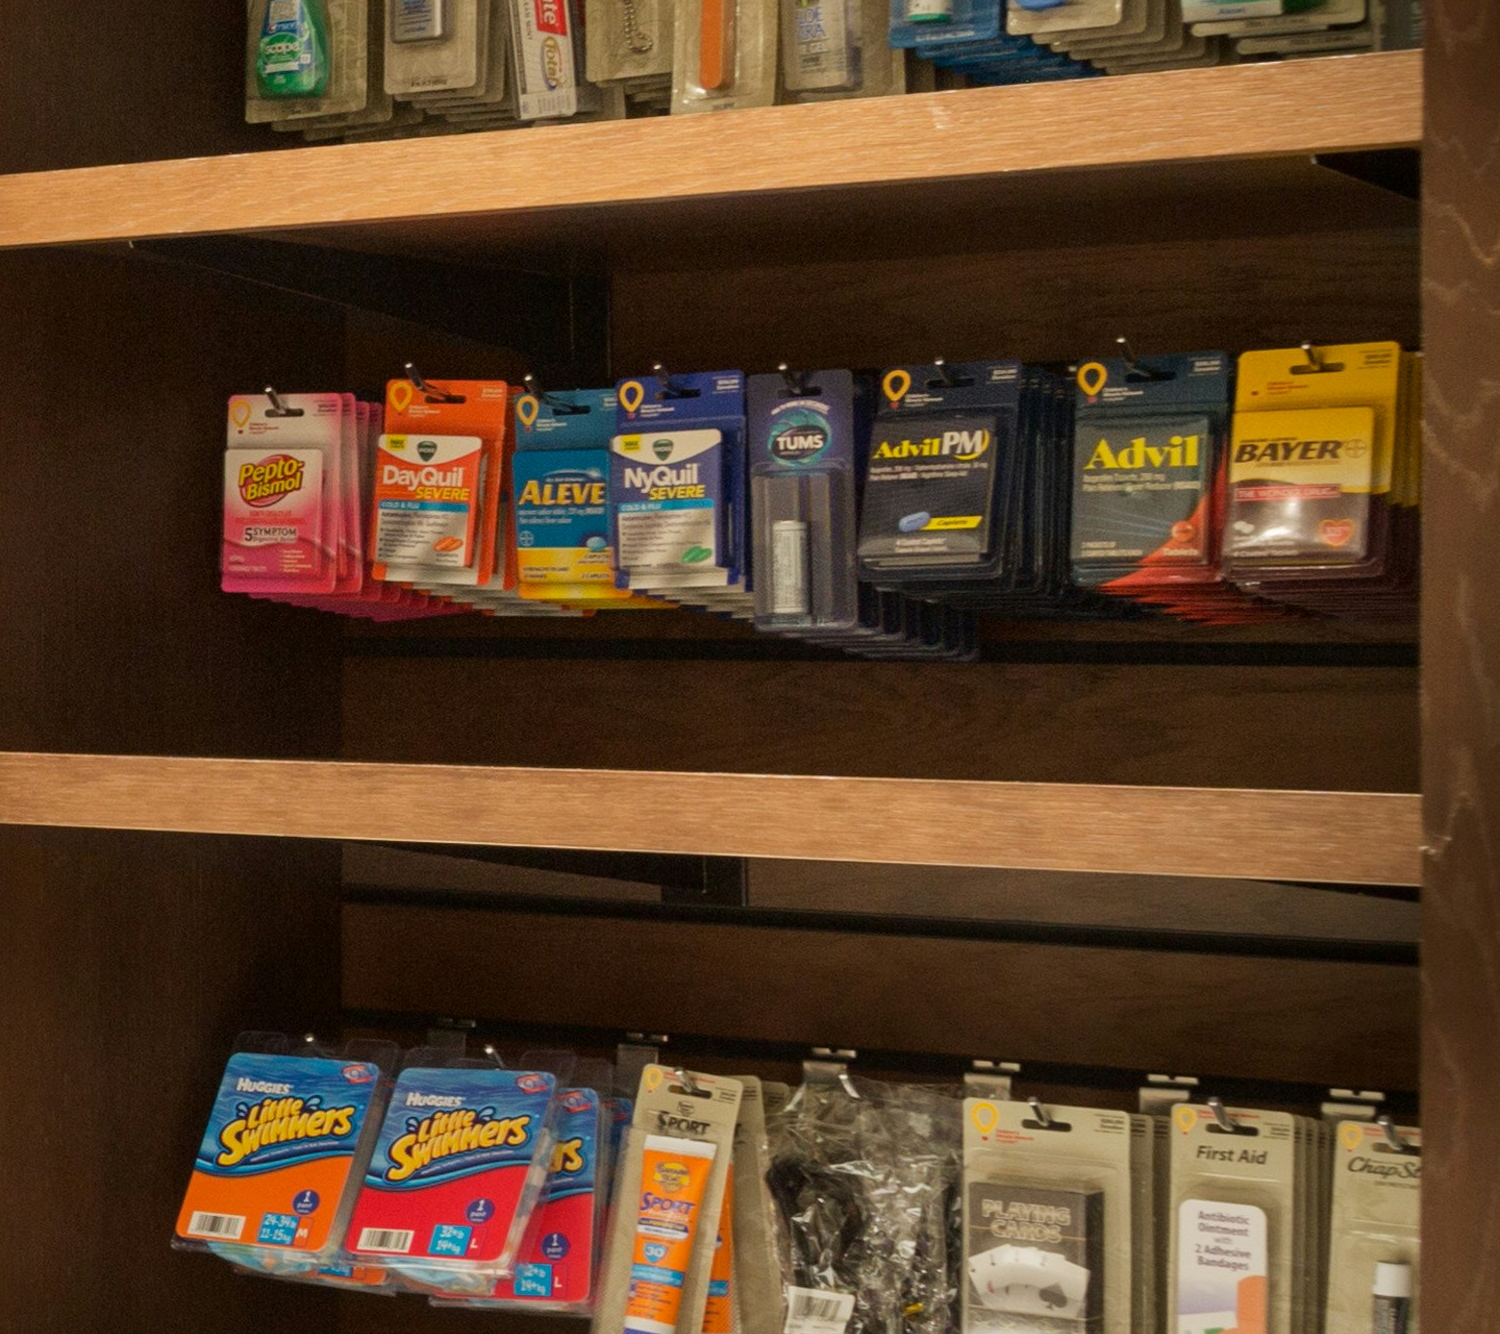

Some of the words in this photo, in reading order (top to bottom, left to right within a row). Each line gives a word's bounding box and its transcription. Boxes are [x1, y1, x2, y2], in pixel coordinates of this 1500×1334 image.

[541, 36, 567, 92] Total
[776, 433, 825, 451] TUMS
[872, 437, 940, 460] Advil
[941, 430, 985, 457] PM
[1083, 435, 1200, 470] Advil
[1234, 440, 1344, 464] BAYER
[237, 457, 304, 486] Pepto-
[382, 465, 465, 491] DayQuil
[624, 463, 699, 492] NyQuil
[245, 474, 303, 502] Bismol
[414, 486, 470, 501] SEVERE
[518, 479, 605, 506] ALEVE
[649, 485, 705, 501] SEVERE
[243, 527, 253, 542] 5
[252, 526, 298, 538] SYMPTOM
[236, 1077, 294, 1094] HUGGIES
[405, 1091, 462, 1107] HUGGIES
[247, 1097, 304, 1128] Little
[656, 1111, 712, 1135] SPORT
[217, 1104, 357, 1167] Swimmers
[417, 1108, 477, 1141] Little
[386, 1114, 530, 1181] Swimmers
[1196, 1146, 1234, 1163] First
[1238, 1148, 1268, 1166] Aid
[303, 1191, 311, 1204] 1
[477, 1199, 485, 1212] 1
[640, 1192, 696, 1216] SPORT
[981, 1200, 1071, 1226] PLAYING
[1197, 1210, 1251, 1226] Antibiotic
[296, 1227, 308, 1239] M
[990, 1221, 1061, 1245] CARDS
[1197, 1222, 1250, 1238] Ointment
[470, 1238, 479, 1249] L
[645, 1245, 666, 1258] 30
[1194, 1243, 1203, 1255] 2
[1203, 1245, 1252, 1259] Adhesive
[1197, 1254, 1250, 1272] Bandages
[554, 1276, 563, 1289] L
